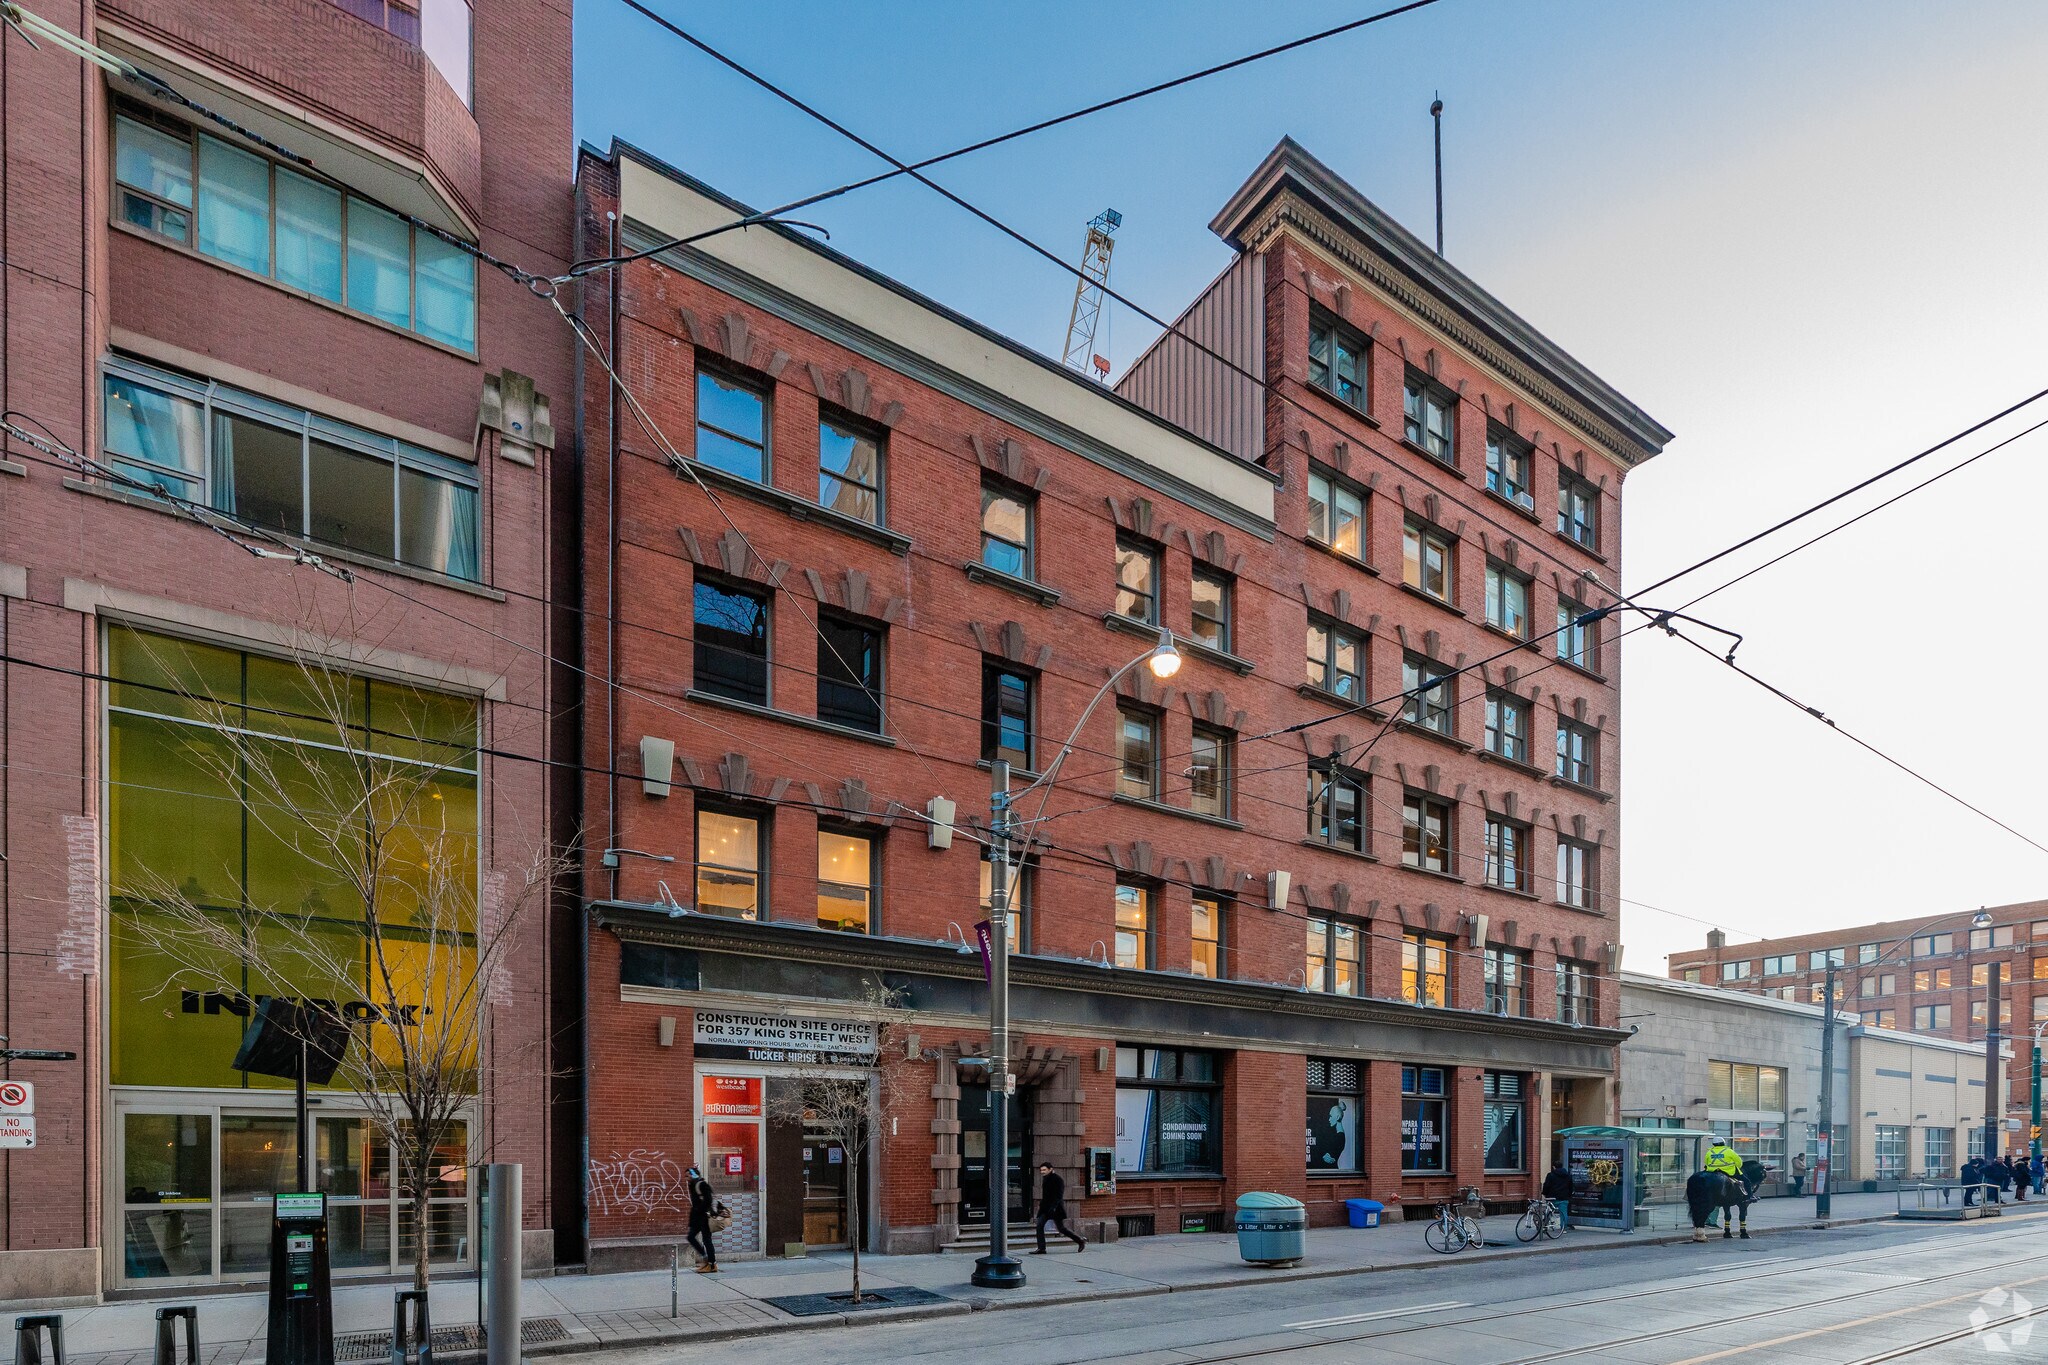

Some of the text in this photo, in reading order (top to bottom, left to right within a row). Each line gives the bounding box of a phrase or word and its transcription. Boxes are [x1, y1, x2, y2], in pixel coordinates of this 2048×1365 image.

[696, 1012, 872, 1034] CONSTRUCTION SITE OFFICE
[697, 1024, 870, 1044] FOR 357 KING STREET WEST
[794, 1041, 809, 1049] MON
[748, 1049, 785, 1062] TUCKER
[705, 1103, 736, 1114] BURTON
[6, 1118, 20, 1127] NO
[1162, 1122, 1207, 1131] CONDOMINIUMS
[1162, 1131, 1203, 1140] COMING SOON
[1419, 1142, 1433, 1150] SOON
